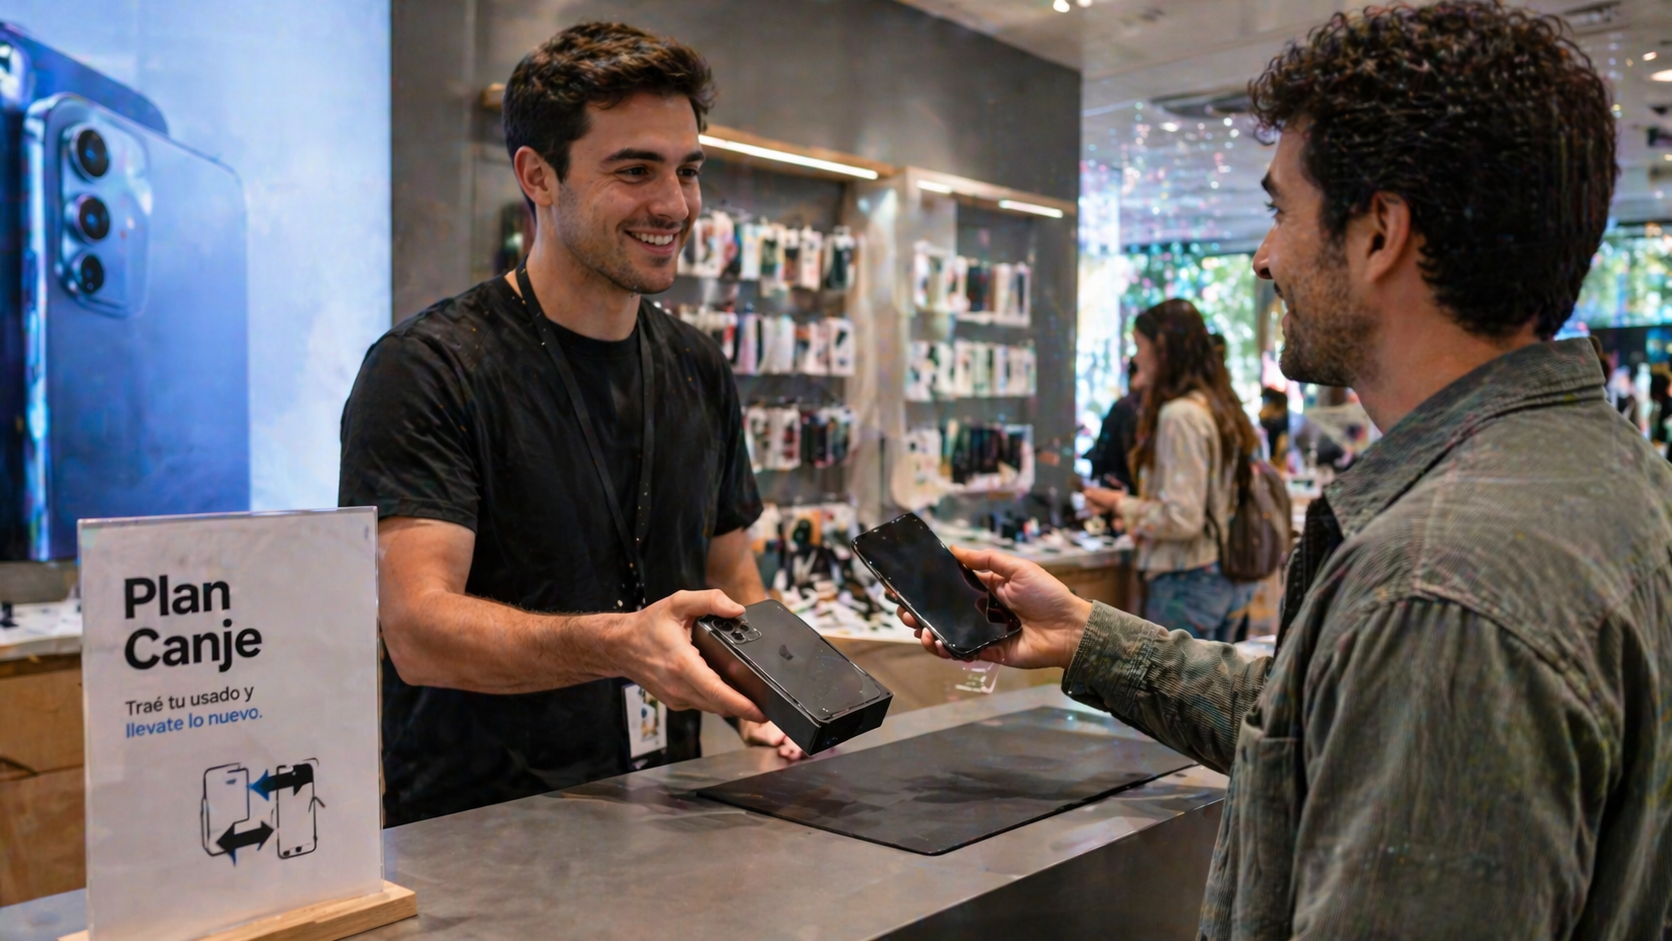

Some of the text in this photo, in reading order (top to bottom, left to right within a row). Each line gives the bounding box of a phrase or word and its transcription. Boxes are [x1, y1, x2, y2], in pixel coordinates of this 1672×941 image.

[124, 574, 231, 620] Plan
[123, 618, 263, 673] Canje
[125, 685, 254, 716] Traé tu usado y
[126, 708, 263, 738] llevate lo nuevo.
